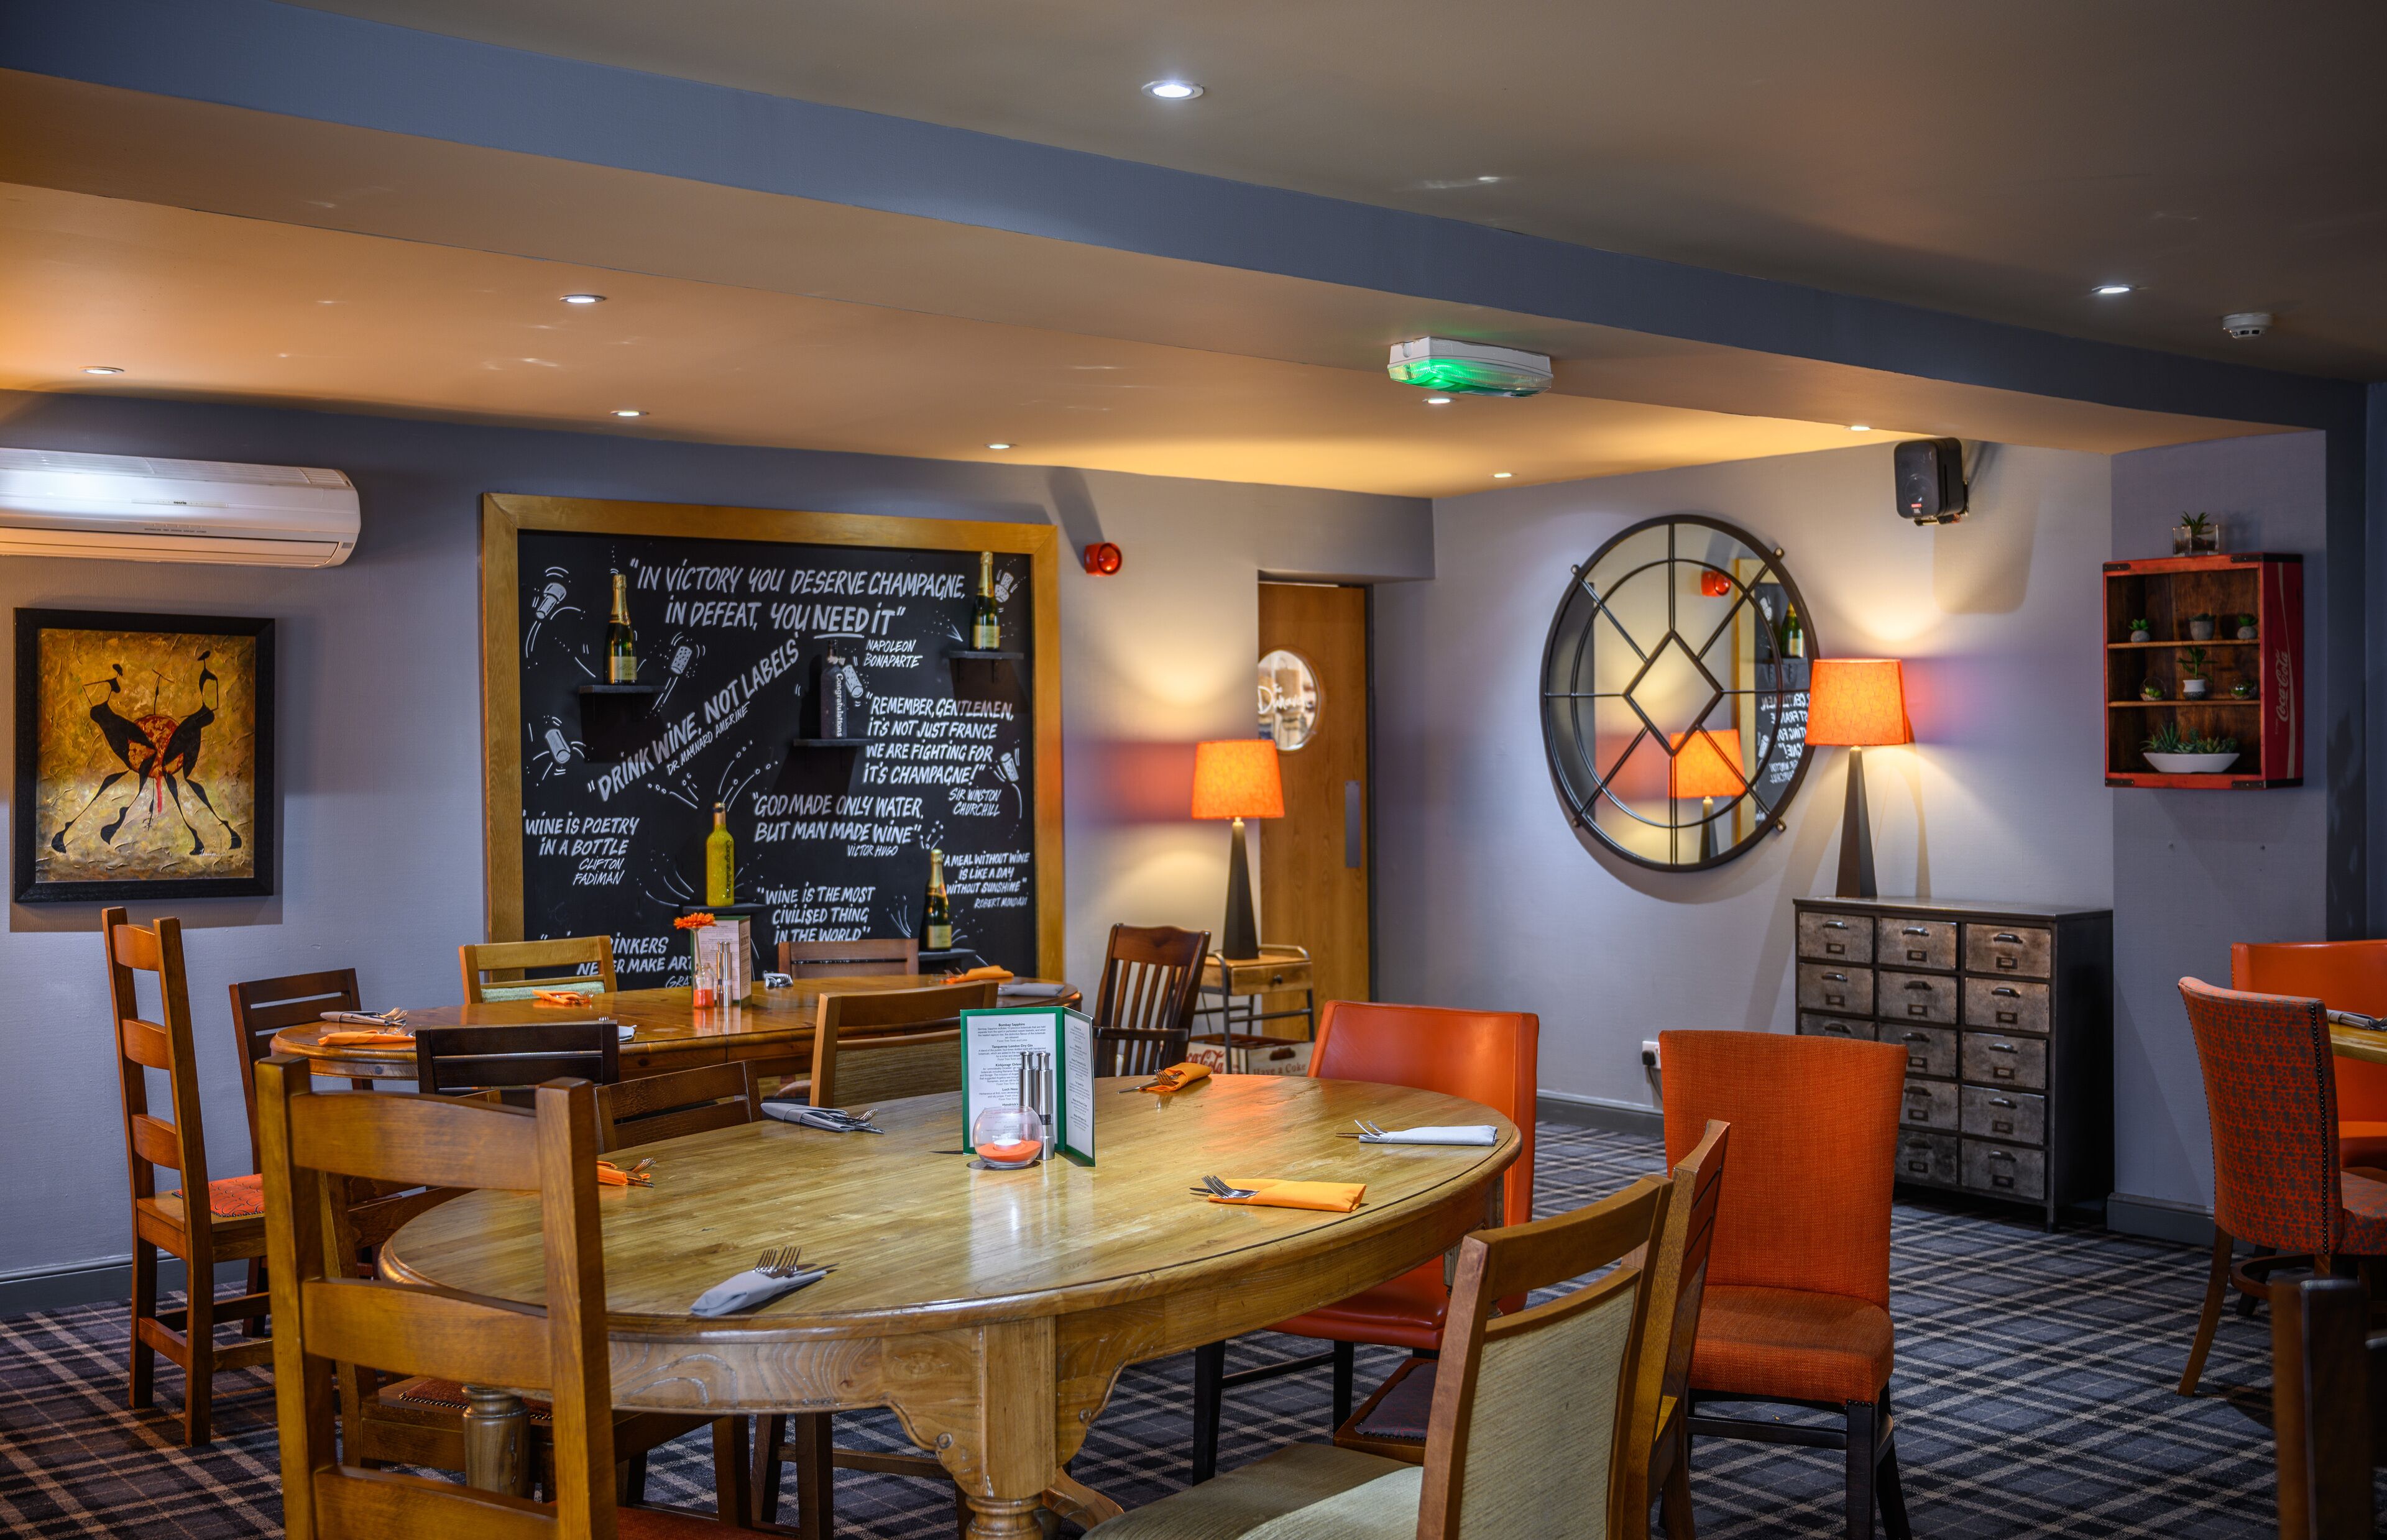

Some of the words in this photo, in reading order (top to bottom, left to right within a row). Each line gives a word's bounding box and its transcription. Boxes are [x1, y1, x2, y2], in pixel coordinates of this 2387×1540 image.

[666, 559, 744, 594] VICTORY
[748, 567, 785, 593] YOU
[790, 569, 868, 595] DESERVE
[868, 571, 965, 600] CHAMPAGNE,
[665, 595, 687, 625] IN
[690, 601, 762, 631] DEFEAT,
[770, 602, 811, 632] YOU
[812, 603, 870, 633] NEED
[871, 602, 906, 636] IT"
[865, 639, 916, 653] NAPOLEON
[863, 653, 923, 669] BONAPARTE
[835, 673, 844, 738] Congratulations
[936, 698, 1014, 721] GENTLEMEN,
[652, 712, 702, 764] WINE,
[703, 679, 739, 724] NOT
[867, 717, 890, 736] IT'S
[891, 720, 919, 736] NOT
[916, 720, 949, 738] JUST
[949, 722, 998, 740] FRANCE
[667, 759, 680, 776] DR
[681, 731, 713, 766] MAYNARD
[865, 743, 885, 758] WE
[885, 743, 909, 759] ARE
[910, 738, 967, 762] FIGHTING
[967, 745, 994, 763] FOR
[863, 761, 889, 784] IT'S
[948, 787, 967, 801] SIR
[967, 786, 1001, 802] WINSTON
[788, 794, 833, 817] MADE
[835, 795, 875, 817] ONLY
[952, 802, 1001, 817] CHURCHILL
[565, 810, 581, 835] IS
[582, 817, 640, 836] POETRY
[754, 821, 791, 843] BUT
[791, 821, 829, 840] MAN
[830, 821, 872, 843] MADE
[539, 836, 557, 857] IN
[559, 838, 569, 856] A
[571, 838, 629, 857] BOTTLE
[847, 842, 874, 858] VICTOR
[874, 845, 899, 858] HUGO
[579, 856, 625, 871] CLIFTON
[951, 853, 973, 867] MEAL
[975, 850, 1009, 866] WITHOUT
[1009, 849, 1031, 864] WINE
[573, 869, 625, 886] FADIMAN
[958, 866, 969, 881] IS
[969, 865, 988, 880] LIKE
[988, 867, 995, 879] A
[995, 866, 1015, 879] DAY
[802, 881, 816, 902] IS
[817, 886, 841, 902] THE
[841, 886, 876, 903] MOST
[946, 880, 982, 896] WITHOUT
[974, 897, 1001, 909] ROBERT
[771, 903, 828, 925] CIVILISED
[830, 903, 870, 924] THING
[773, 925, 788, 946] IN
[791, 927, 817, 942] THE
[626, 957, 666, 974] MAKE
